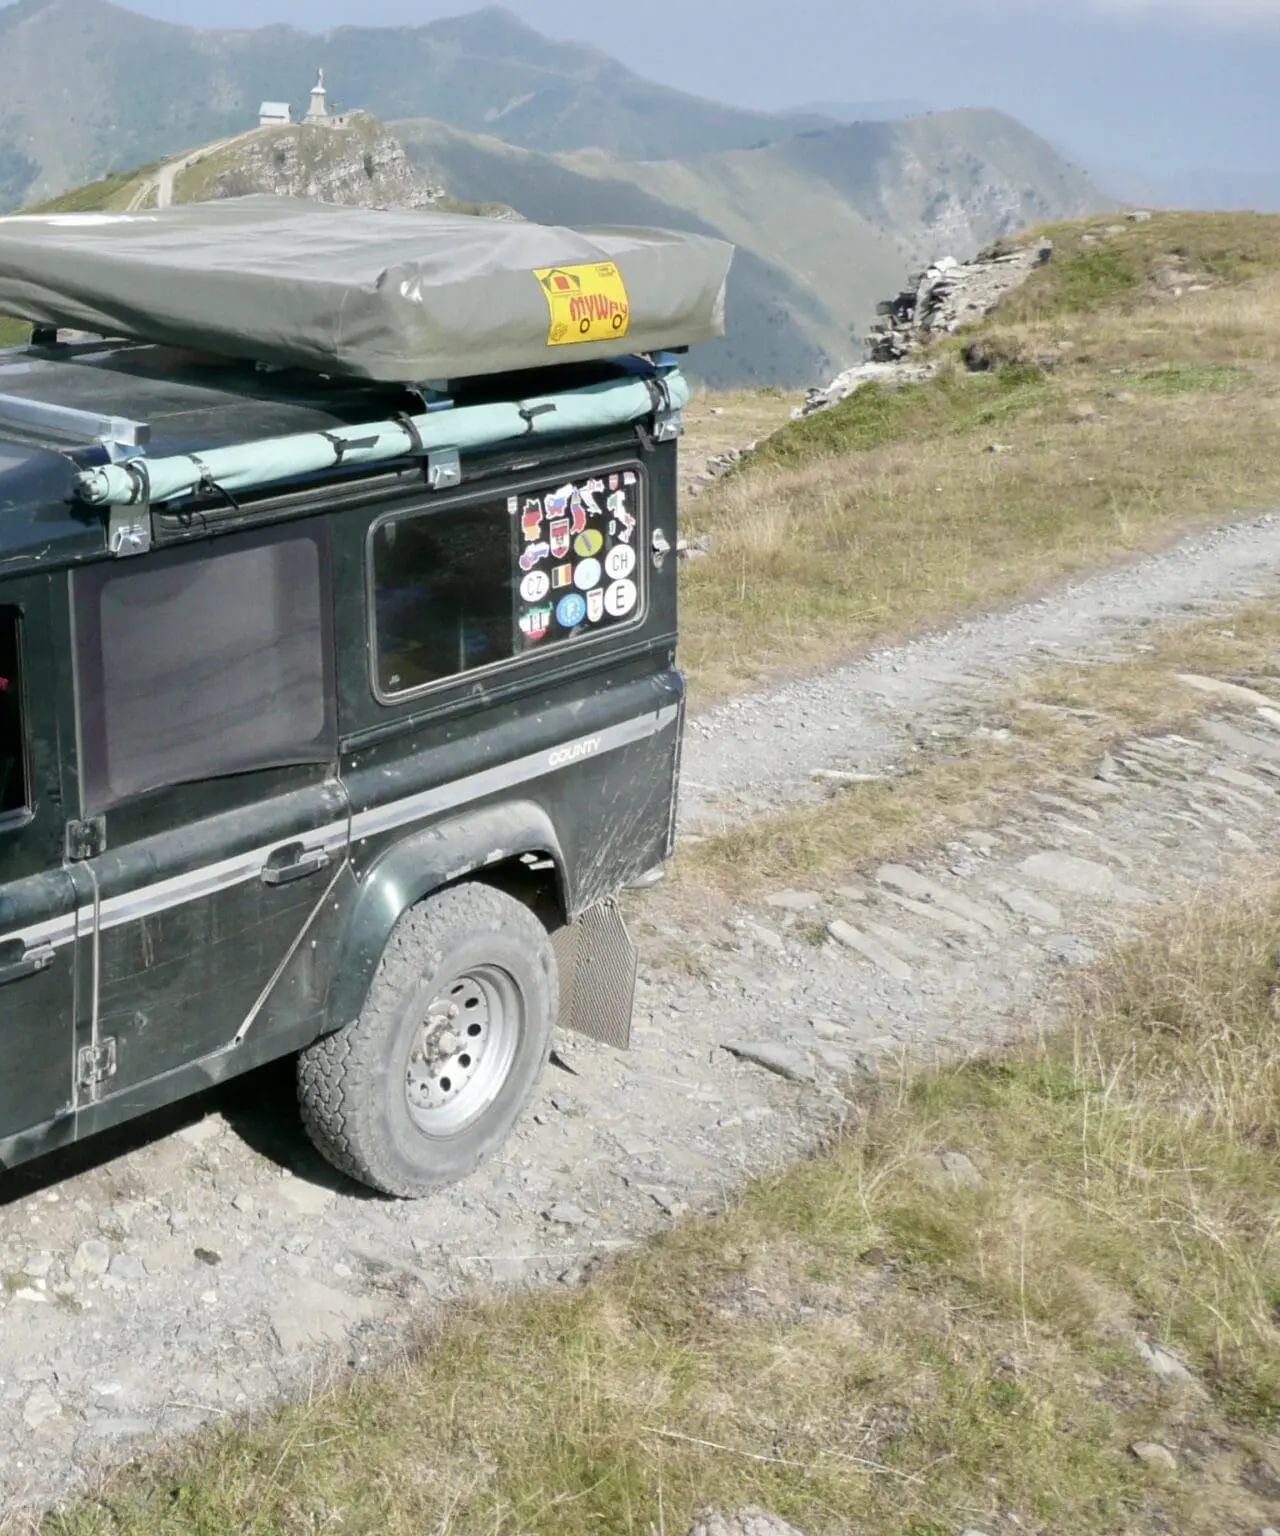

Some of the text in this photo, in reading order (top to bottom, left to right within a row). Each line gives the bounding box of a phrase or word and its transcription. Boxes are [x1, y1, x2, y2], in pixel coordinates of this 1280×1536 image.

[612, 551, 629, 571] CH
[527, 575, 543, 597] CZ
[616, 585, 625, 609] E
[548, 737, 601, 766] COUNTY
